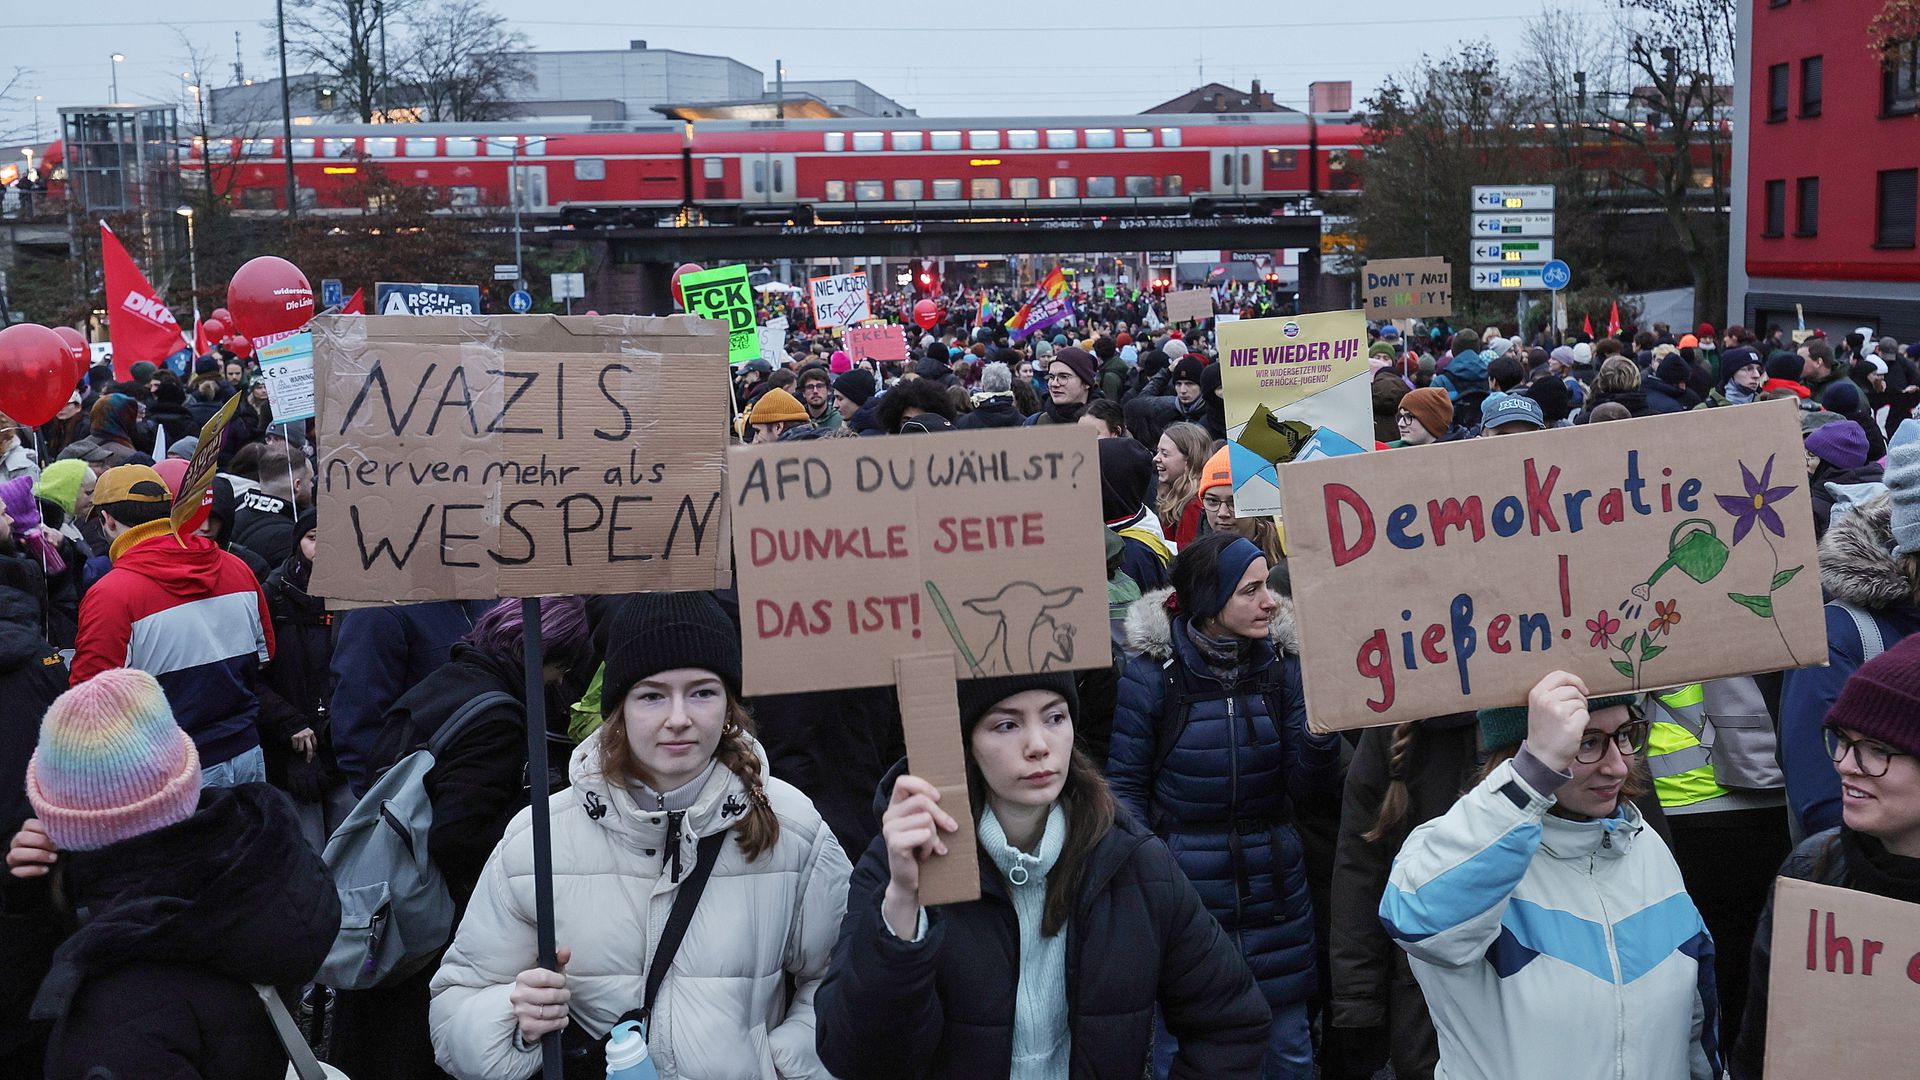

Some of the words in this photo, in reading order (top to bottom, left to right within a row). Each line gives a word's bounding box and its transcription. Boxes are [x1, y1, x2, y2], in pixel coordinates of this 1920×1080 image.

[815, 279, 834, 298] NIE
[835, 275, 867, 293] WIEDER
[1368, 273, 1415, 289] DON'T
[1420, 272, 1448, 285] NAZI
[123, 290, 177, 325] DKP
[685, 284, 748, 313] FCK
[817, 303, 833, 320] IST
[1373, 296, 1387, 308] BE
[698, 307, 753, 329] FD
[852, 329, 895, 345] EKEL
[1230, 348, 1258, 367] NIE
[1263, 341, 1330, 365] WIEDER
[1334, 338, 1359, 362] HJ!
[1256, 369, 1269, 378] WIR
[1270, 365, 1316, 377] WIDERSETZEN
[1317, 364, 1332, 373] UNS
[1260, 378, 1274, 387] DER
[1275, 374, 1329, 387] HÖCKE-JUGEND!
[339, 360, 633, 441] NAZIS
[326, 457, 468, 492] nerven
[483, 454, 580, 486] mehr
[604, 449, 665, 485] als
[738, 457, 832, 506] AFD
[856, 455, 915, 493] DU
[927, 450, 1085, 490] WÄHLST?
[350, 491, 720, 571] WESPEN
[751, 524, 909, 567] DUNKLE
[933, 512, 1046, 554] SEITE
[756, 598, 833, 639] DAS
[847, 592, 923, 640] IST!
[1356, 554, 1572, 713] gießen!
[1807, 908, 1884, 976] Ihr
